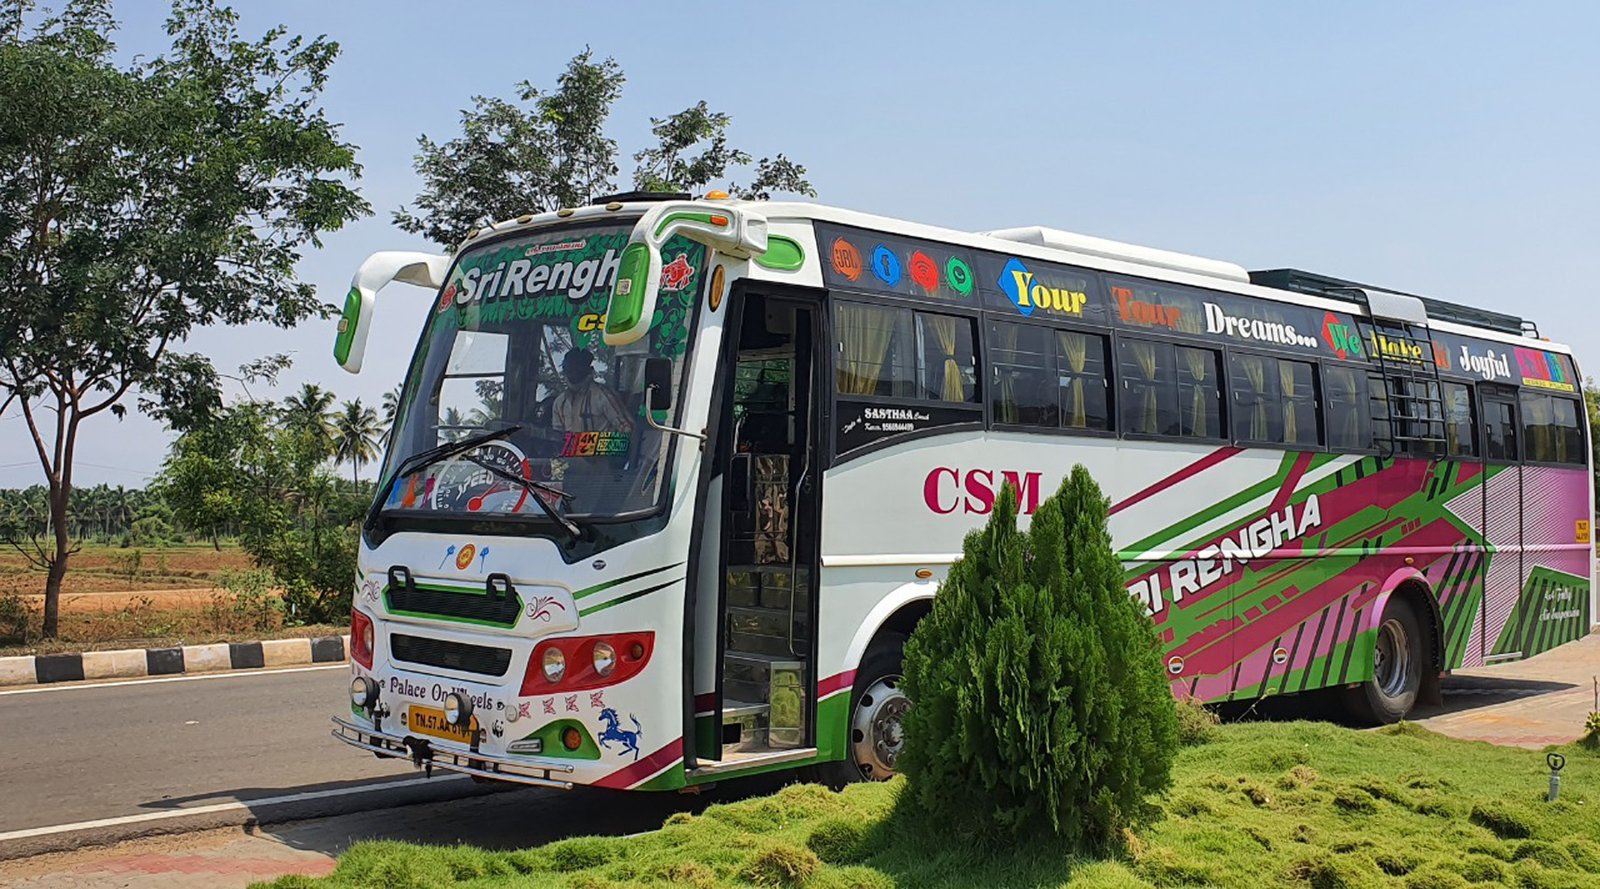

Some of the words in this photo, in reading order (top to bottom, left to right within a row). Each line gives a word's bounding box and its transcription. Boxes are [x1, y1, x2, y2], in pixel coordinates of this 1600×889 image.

[456, 249, 622, 304] SriRengh
[578, 314, 607, 331] CS
[1011, 270, 1087, 314] Your
[1111, 286, 1182, 331] Tour
[1202, 302, 1318, 348] Dreams...
[1327, 323, 1361, 354] We
[1459, 345, 1512, 381] Joyful
[864, 407, 914, 420] SASTHAA
[580, 433, 597, 444] 4K
[924, 467, 1043, 515] CSM
[1127, 573, 1163, 618] RI
[1169, 494, 1321, 603] RENGHA
[390, 676, 426, 699] Palace
[431, 683, 448, 702] On
